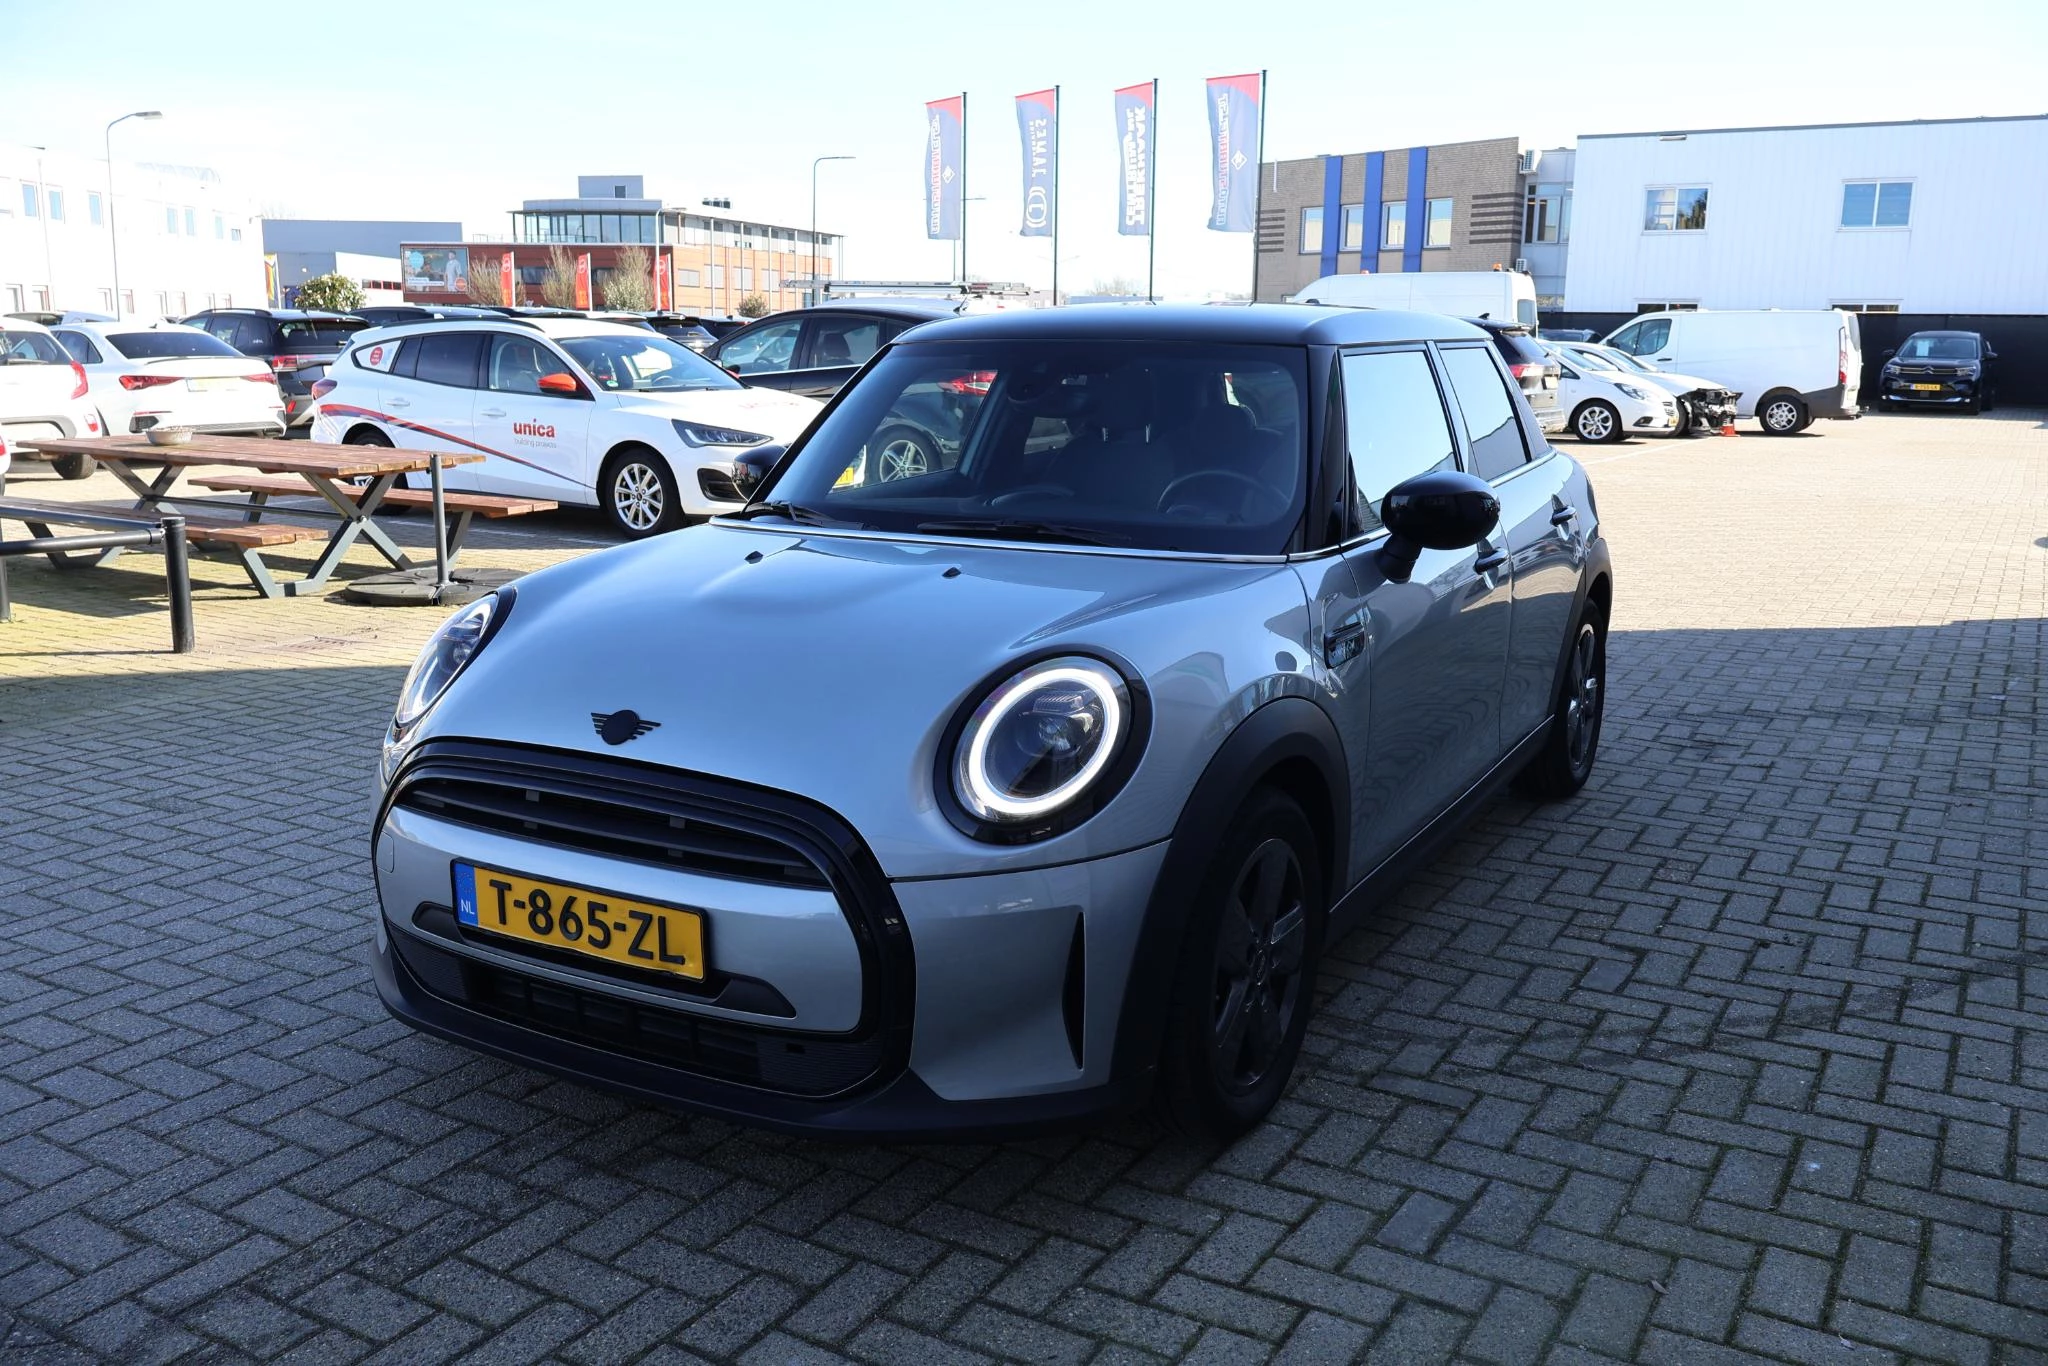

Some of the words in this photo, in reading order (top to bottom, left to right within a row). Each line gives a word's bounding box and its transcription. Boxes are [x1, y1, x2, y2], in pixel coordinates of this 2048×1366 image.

[513, 418, 555, 438] unica
[461, 898, 475, 916] NL
[489, 879, 686, 966] T-865-ZL
